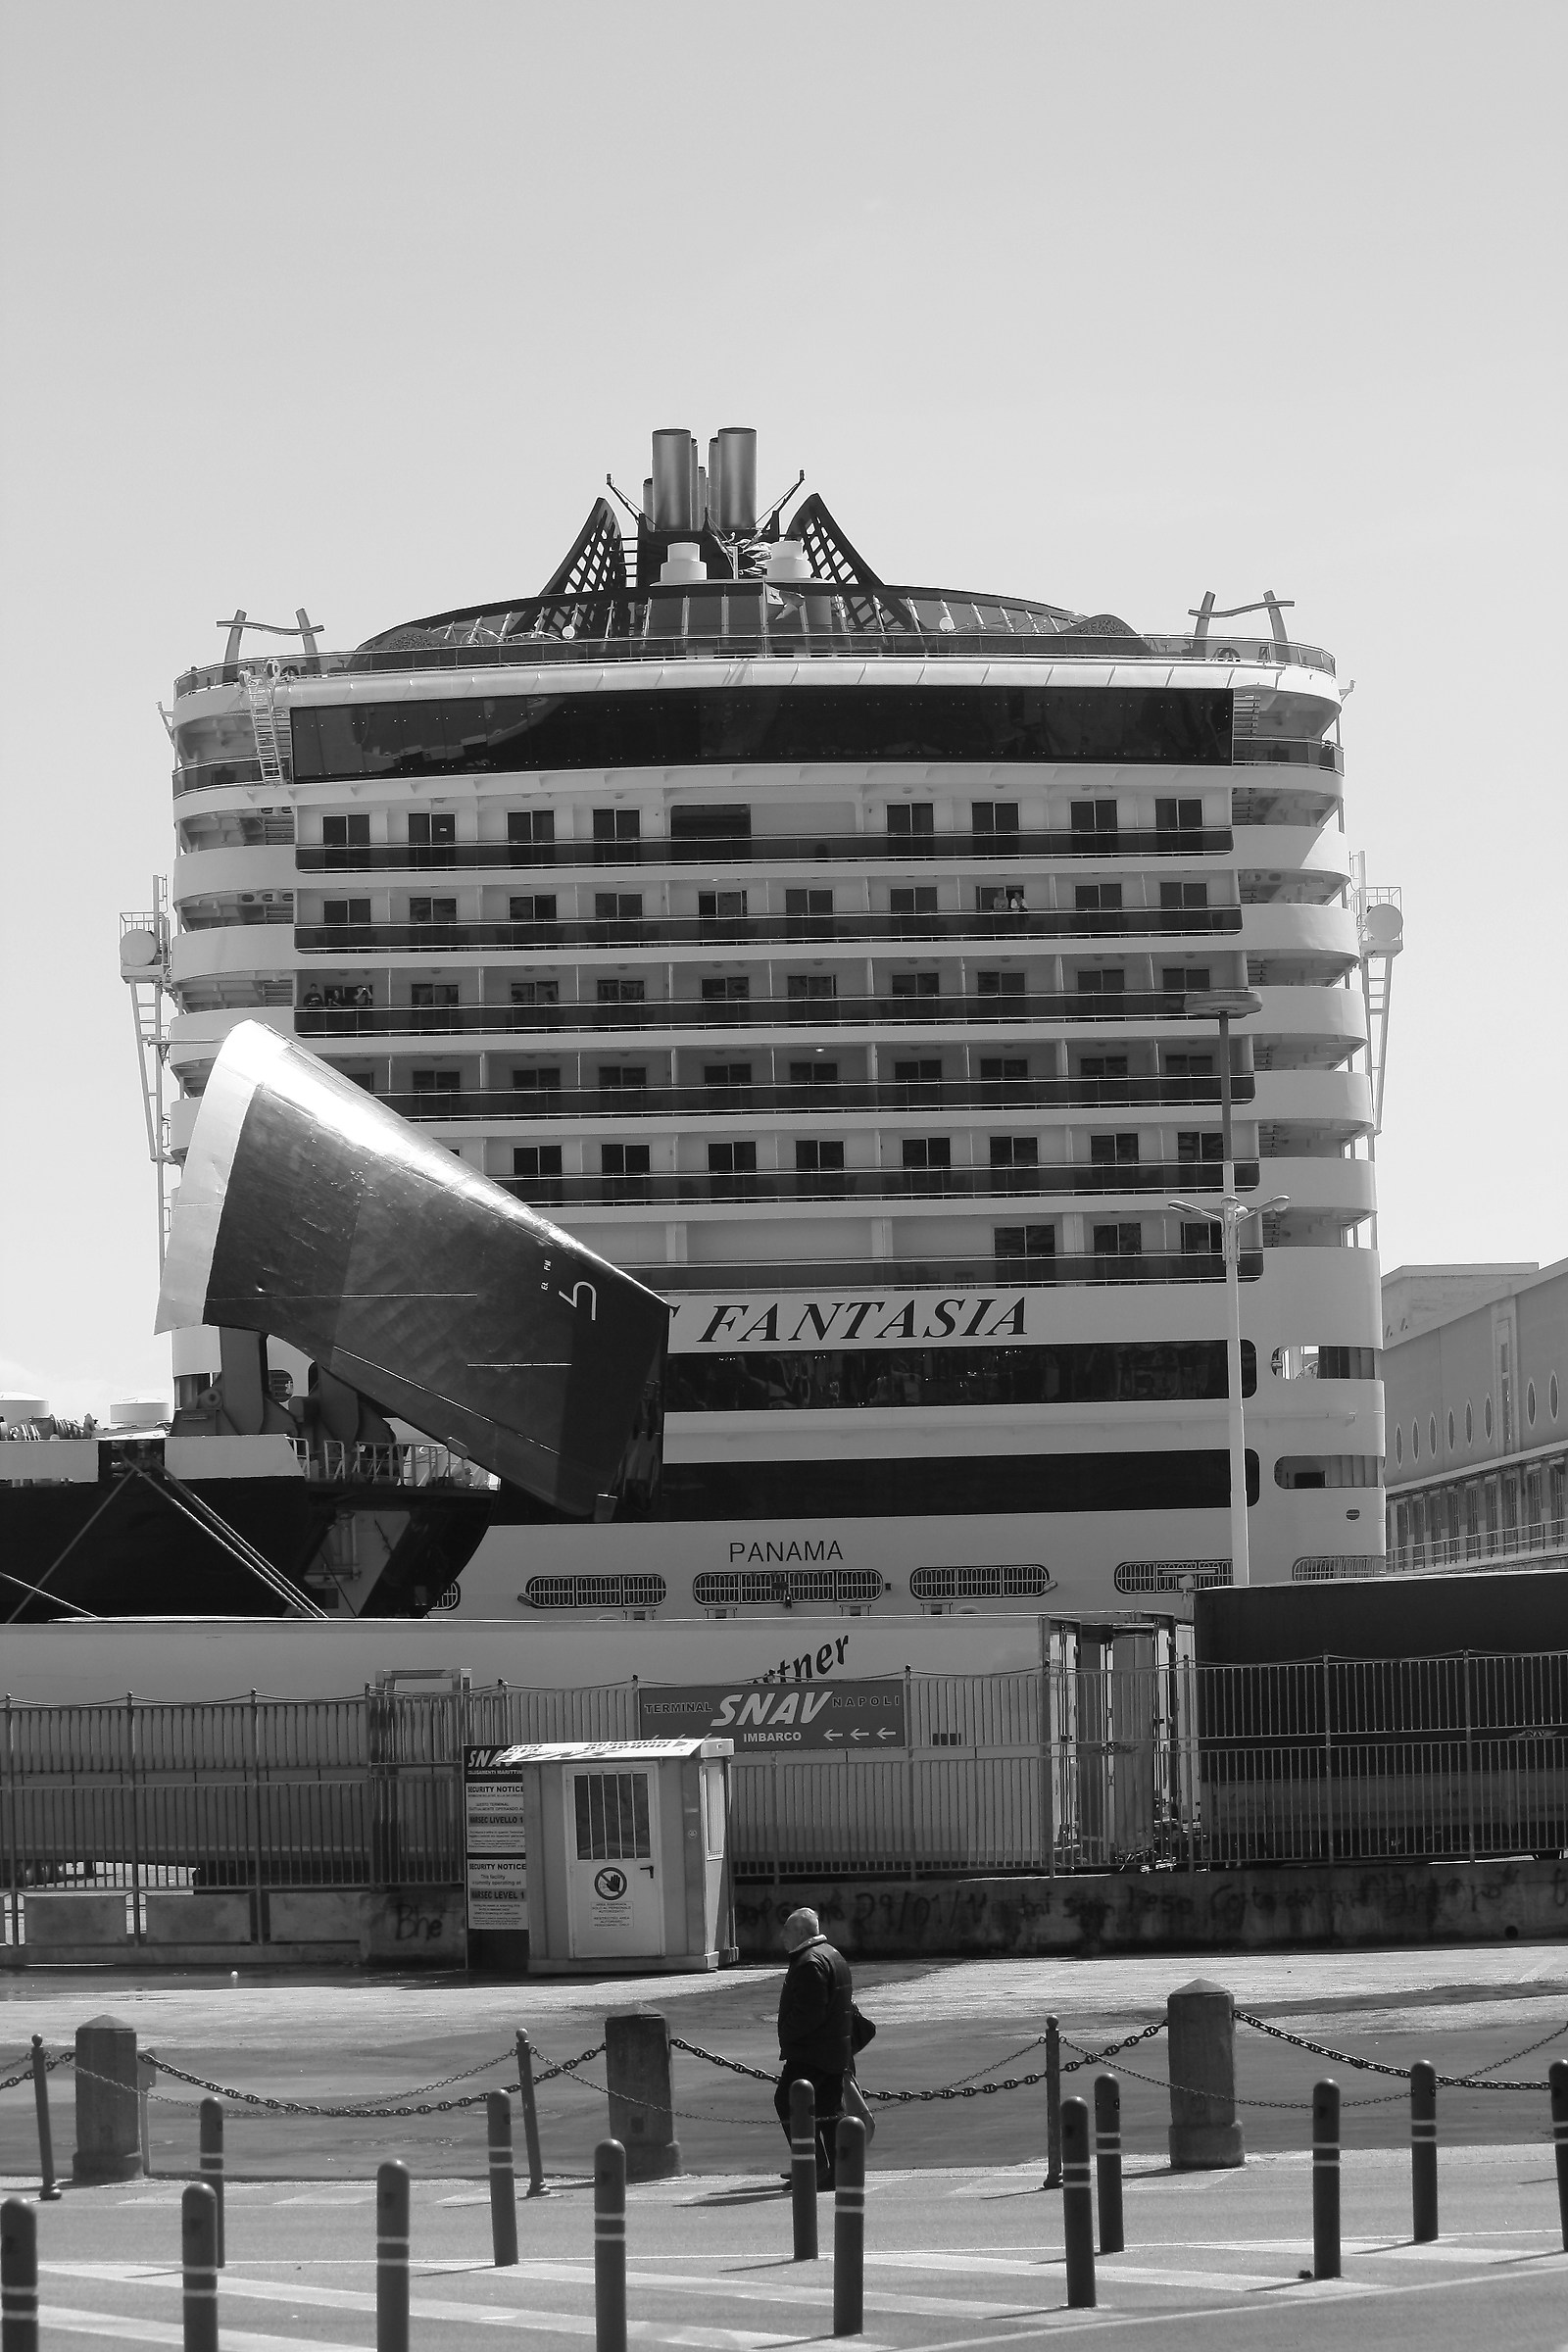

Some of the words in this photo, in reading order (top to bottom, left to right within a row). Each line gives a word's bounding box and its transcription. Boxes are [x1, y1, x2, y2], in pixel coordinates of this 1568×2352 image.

[697, 1297, 1028, 1344] FANTASIA
[730, 1541, 843, 1563] PANAMA
[747, 1635, 849, 1684] tner
[644, 1701, 712, 1714] TERMINAL
[710, 1691, 833, 1727] SNAV
[833, 1695, 900, 1708] NAPOLI
[743, 1732, 802, 1743] IMBARCO
[467, 1749, 513, 1768] SNA
[494, 1890, 518, 1899] LEVEL
